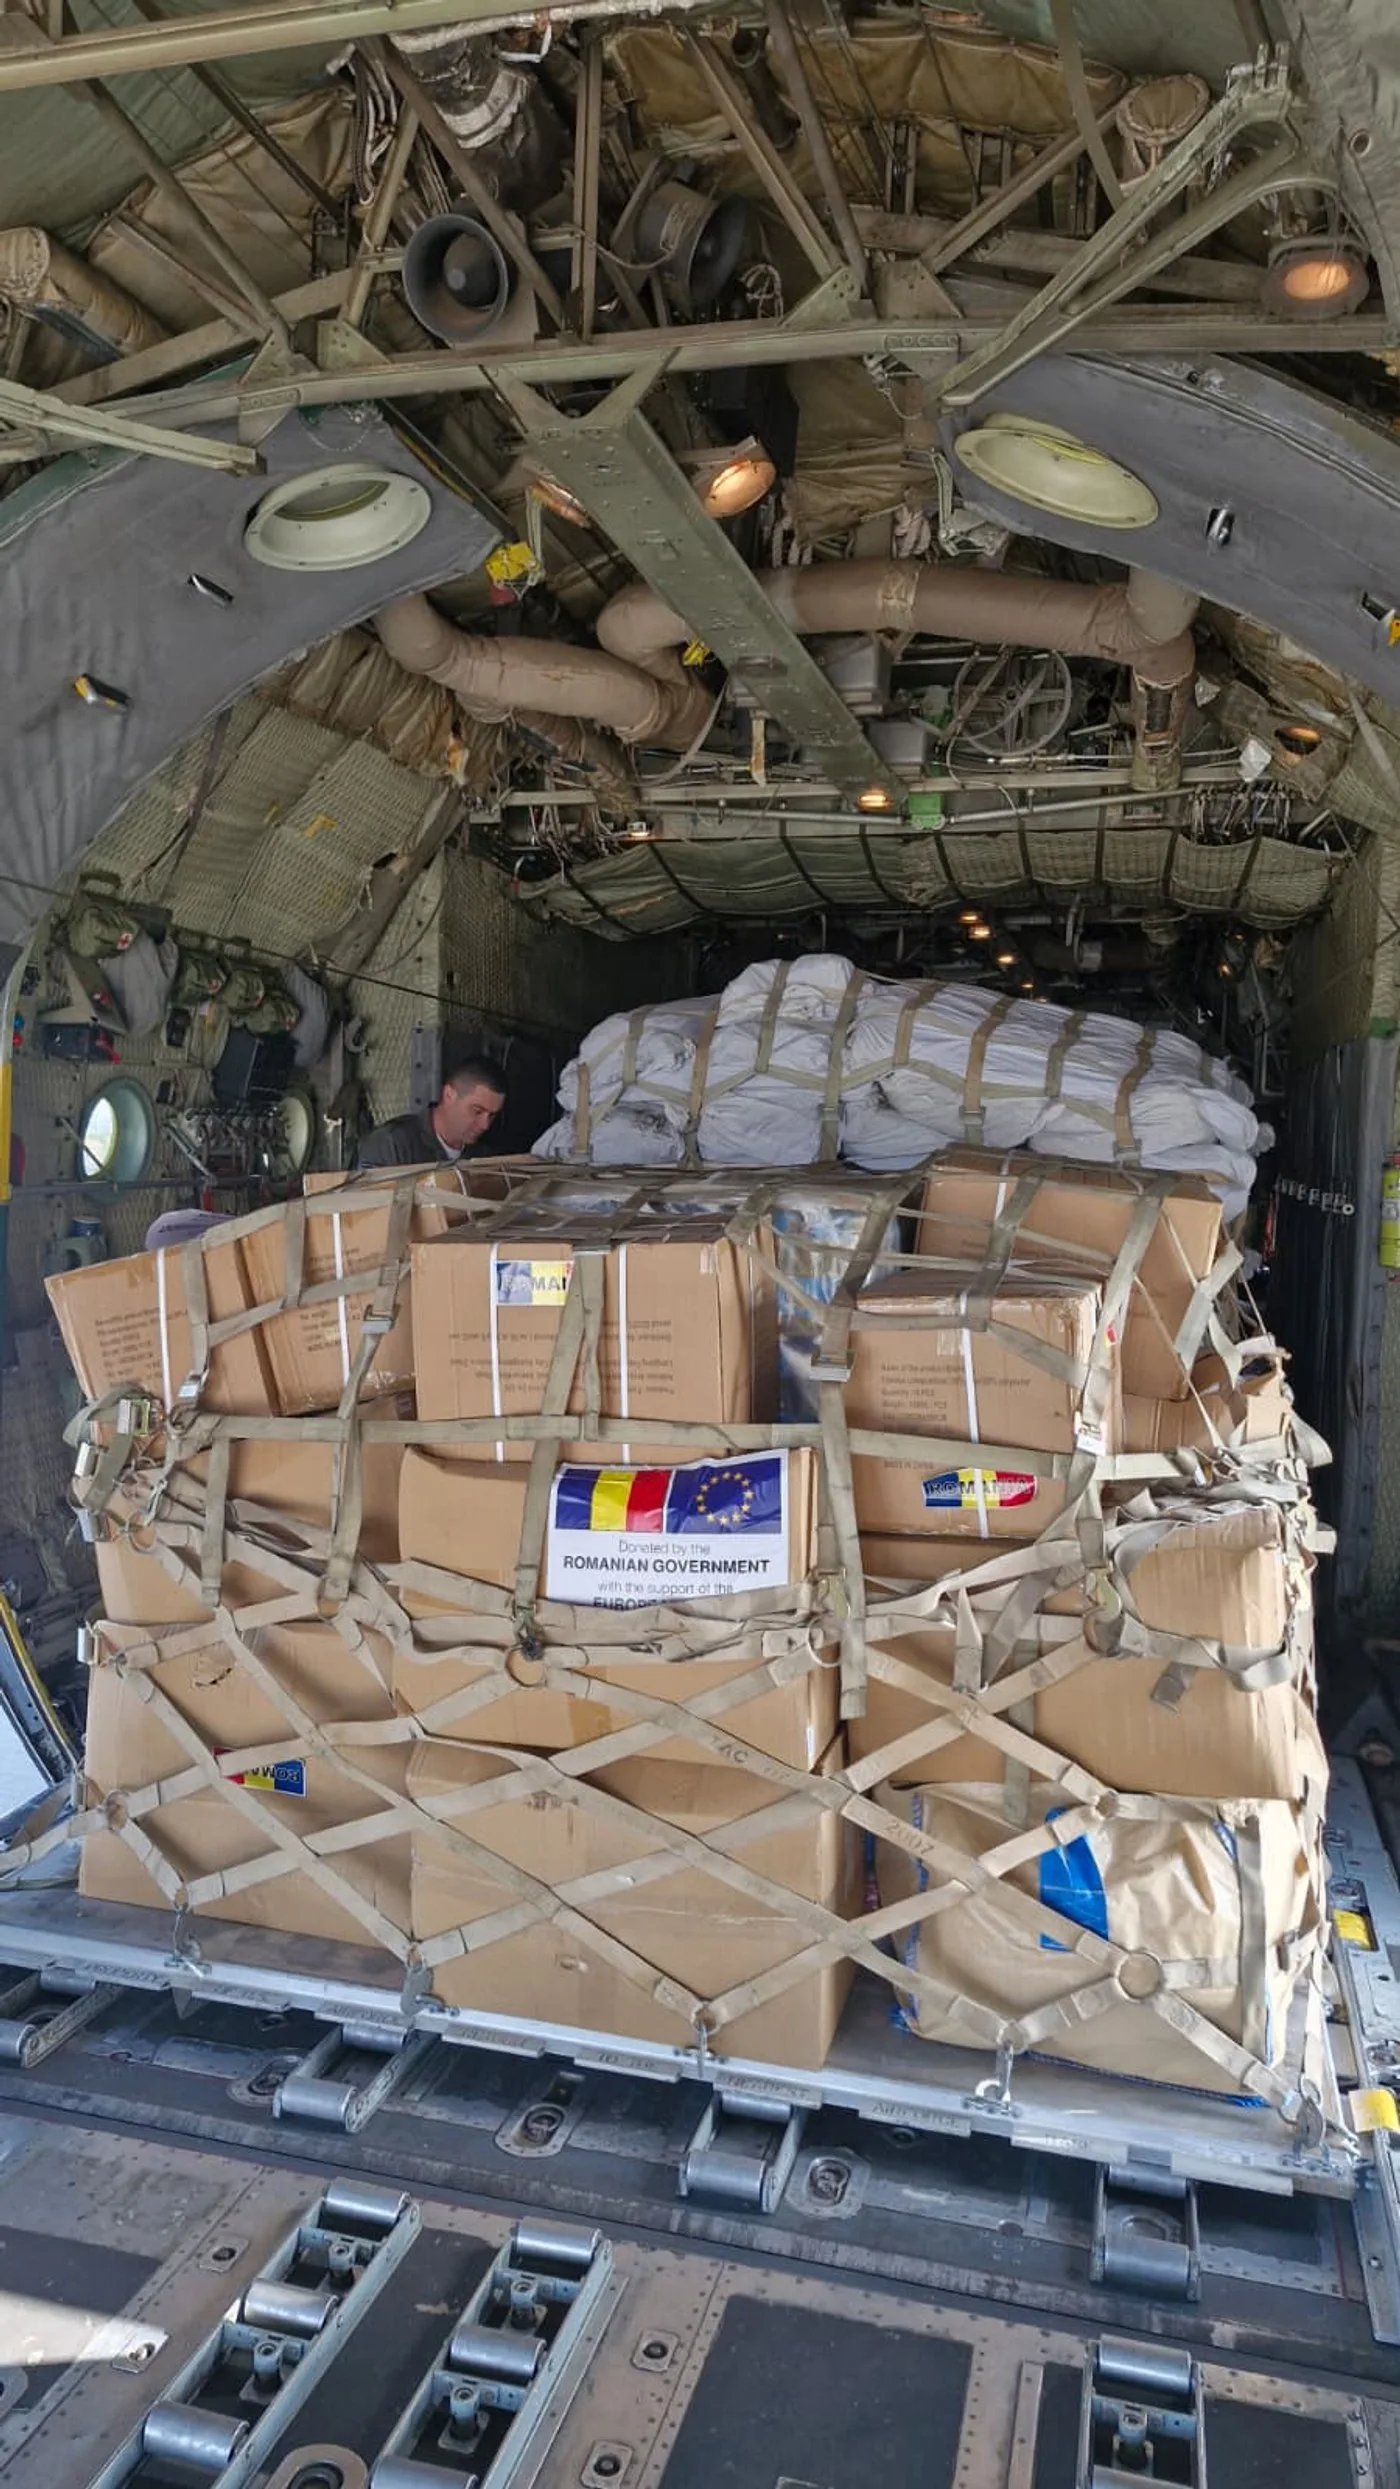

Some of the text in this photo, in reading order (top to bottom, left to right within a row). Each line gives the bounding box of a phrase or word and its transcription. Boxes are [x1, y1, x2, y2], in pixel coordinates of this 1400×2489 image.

[618, 1540, 711, 1555] Donated by the
[563, 1554, 770, 1574] ROMANIAN GOVERNMENT
[598, 1581, 734, 1597] with the support of the
